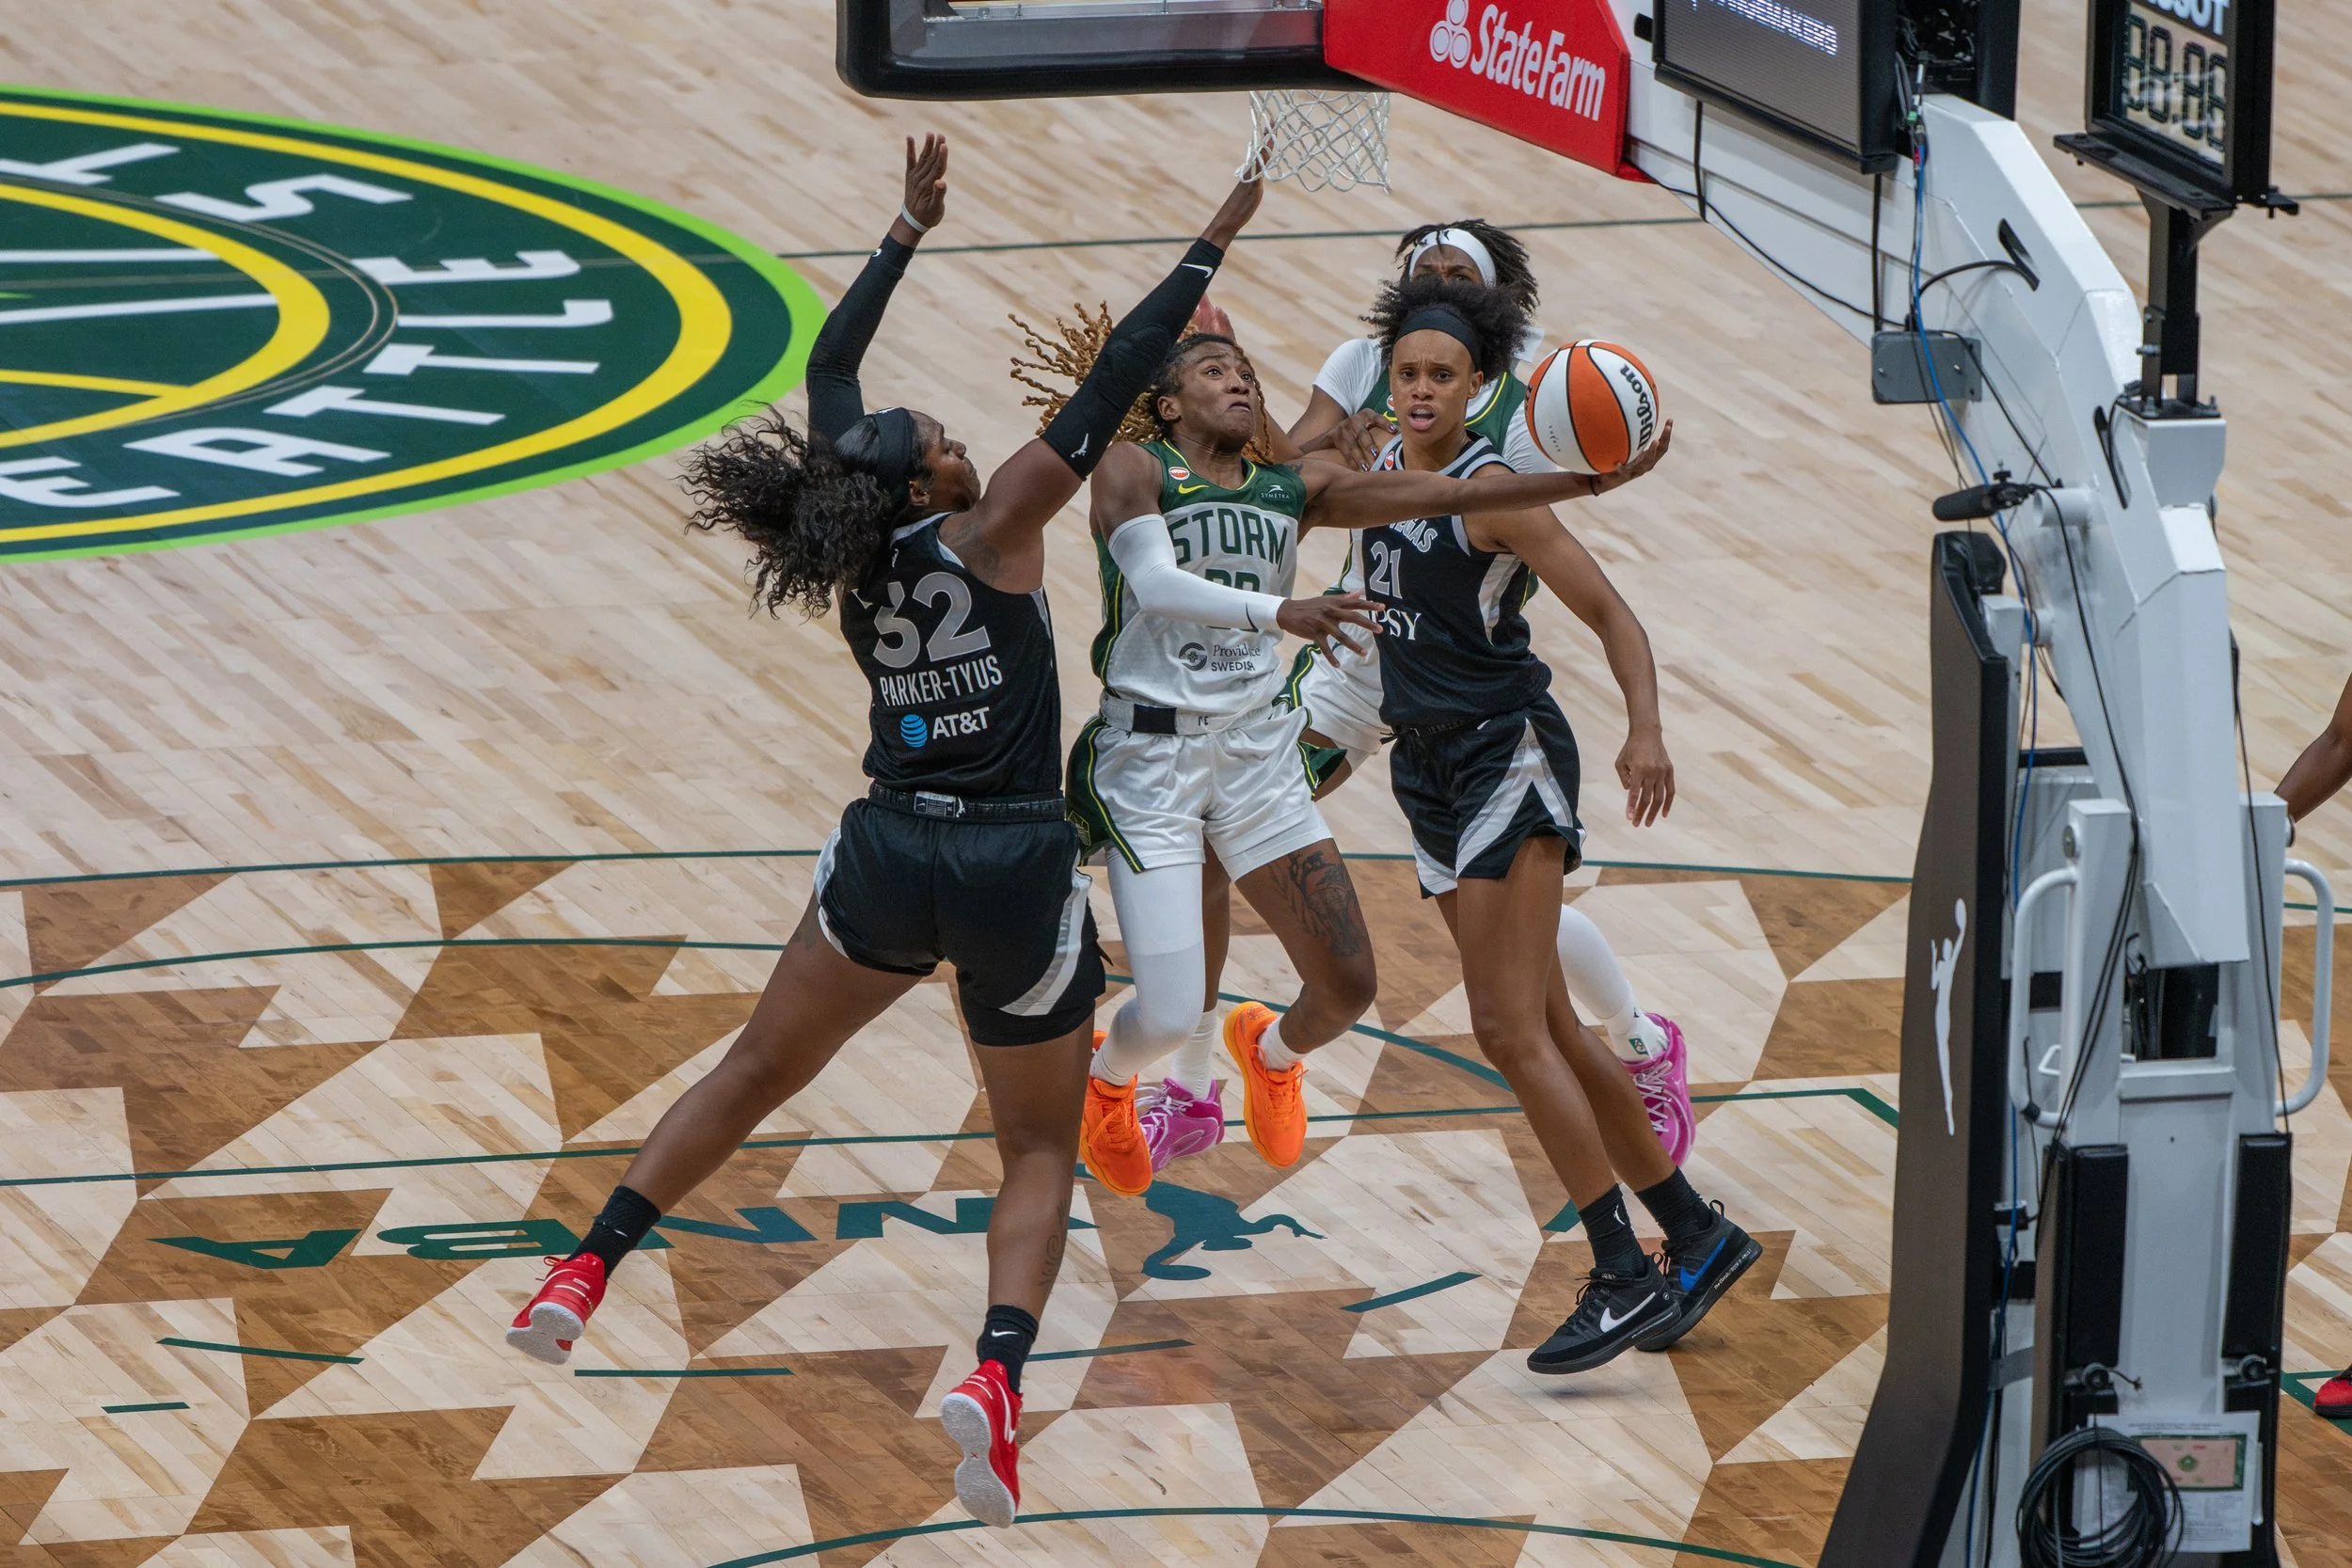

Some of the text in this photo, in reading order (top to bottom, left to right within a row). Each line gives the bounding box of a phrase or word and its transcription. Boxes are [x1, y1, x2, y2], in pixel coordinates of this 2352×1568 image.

[1620, 364, 1654, 451] Wilson
[1167, 508, 1288, 574] STORM
[1390, 518, 1438, 552] EGAS
[1369, 541, 1403, 599] 21
[851, 571, 992, 668] 32
[879, 655, 1003, 706] PARKER-TYUS
[932, 706, 991, 739] AT&T
